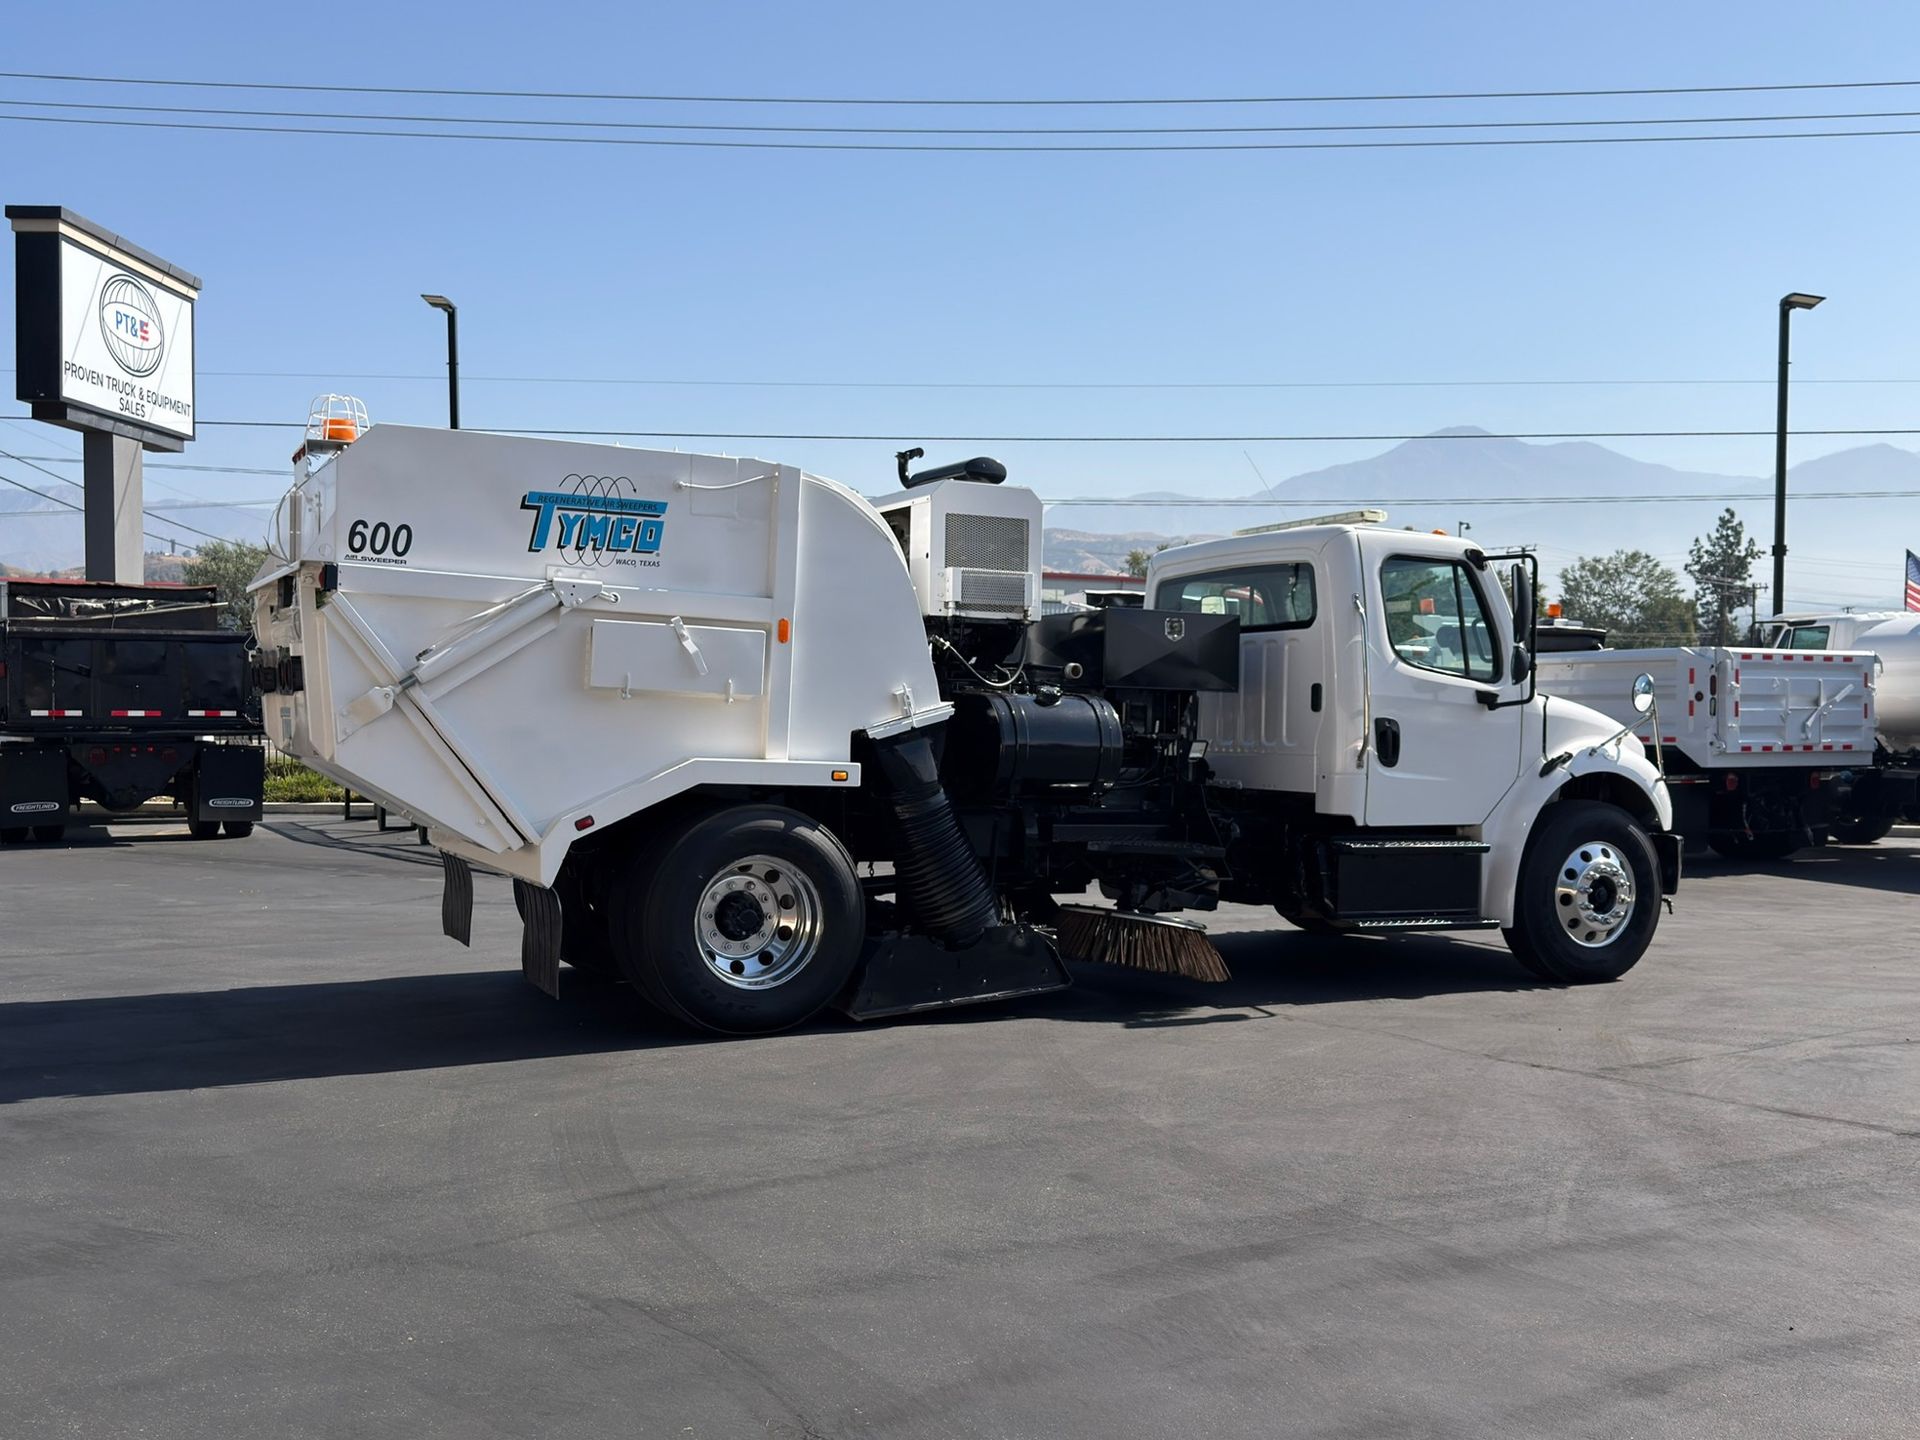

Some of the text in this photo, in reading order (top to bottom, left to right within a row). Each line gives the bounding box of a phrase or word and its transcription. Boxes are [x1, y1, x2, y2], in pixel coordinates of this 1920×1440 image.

[115, 309, 149, 342] PT&E
[64, 360, 191, 417] PROVEN TRUCK & EQUIPMENT
[119, 397, 146, 418] SALES
[537, 495, 658, 511] REGENERATIVE AIR SWEEPERS
[521, 491, 668, 553] TYMCO
[348, 519, 412, 557] 600
[360, 556, 407, 565] SWEEPER
[615, 559, 661, 568] WACO, TEXAS
